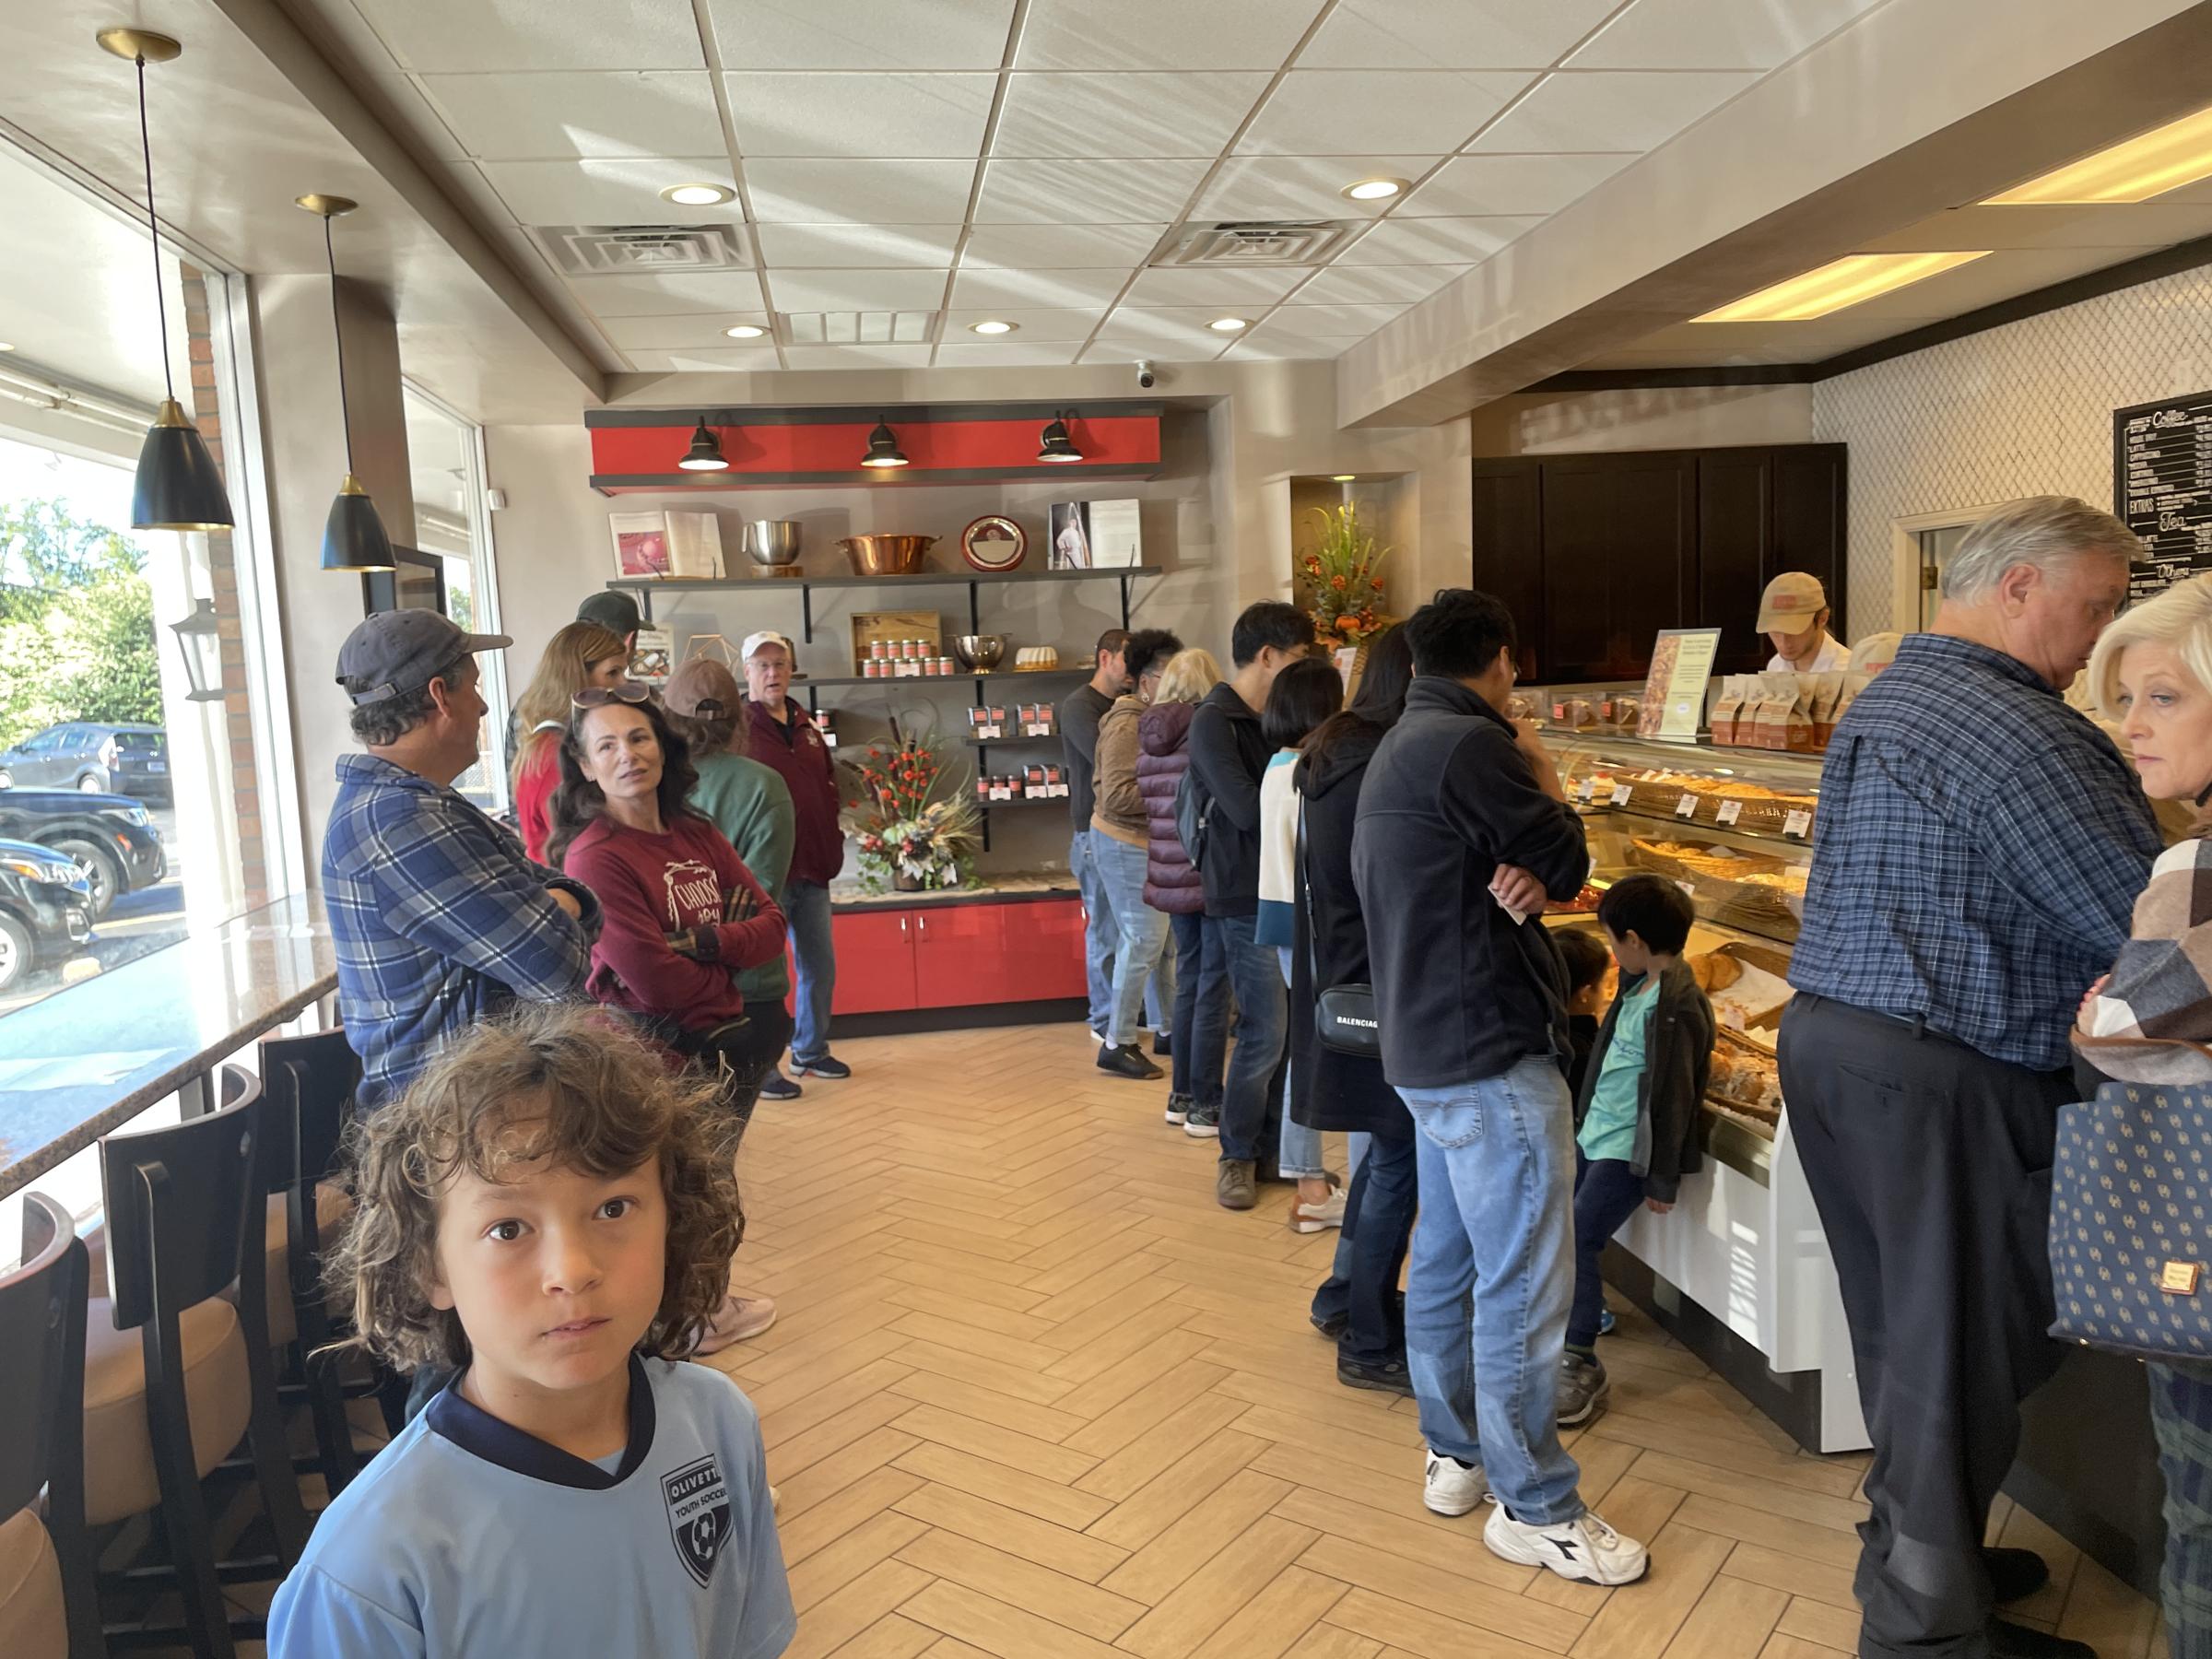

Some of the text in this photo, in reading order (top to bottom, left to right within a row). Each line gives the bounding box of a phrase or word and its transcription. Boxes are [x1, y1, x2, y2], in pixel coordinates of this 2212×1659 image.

[2159, 512, 2187, 532] Tea
[1336, 1016, 1378, 1029] BALENCIAG
[671, 1467, 718, 1499] OLIVETT
[675, 1499, 700, 1518] YOUTH
